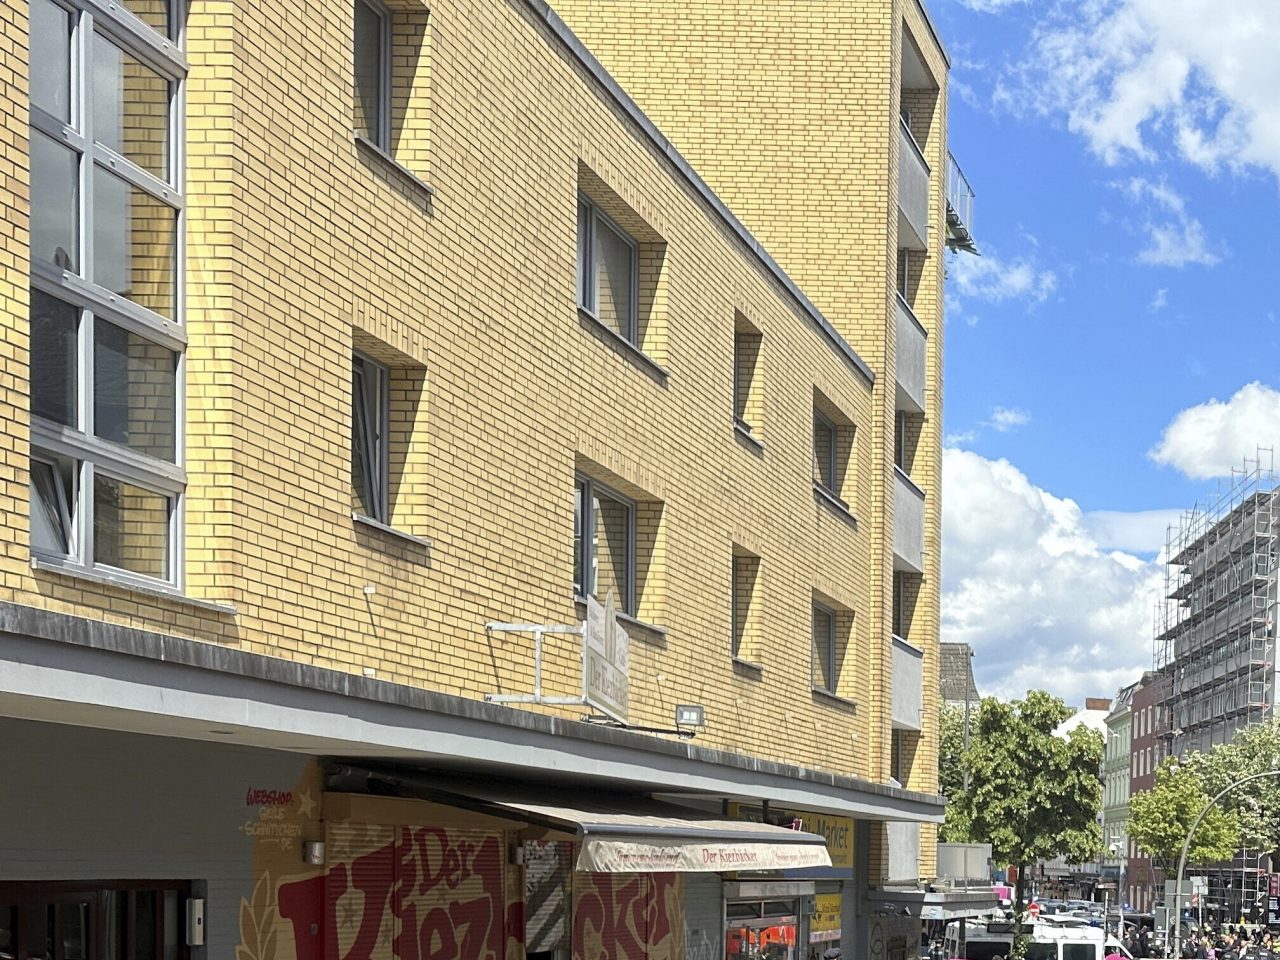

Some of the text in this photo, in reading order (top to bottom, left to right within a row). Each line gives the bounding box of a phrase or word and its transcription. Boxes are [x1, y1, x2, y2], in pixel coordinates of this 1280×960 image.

[415, 825, 476, 897] Der
[702, 848, 718, 864] Der
[719, 849, 758, 864] Kiezbäcker
